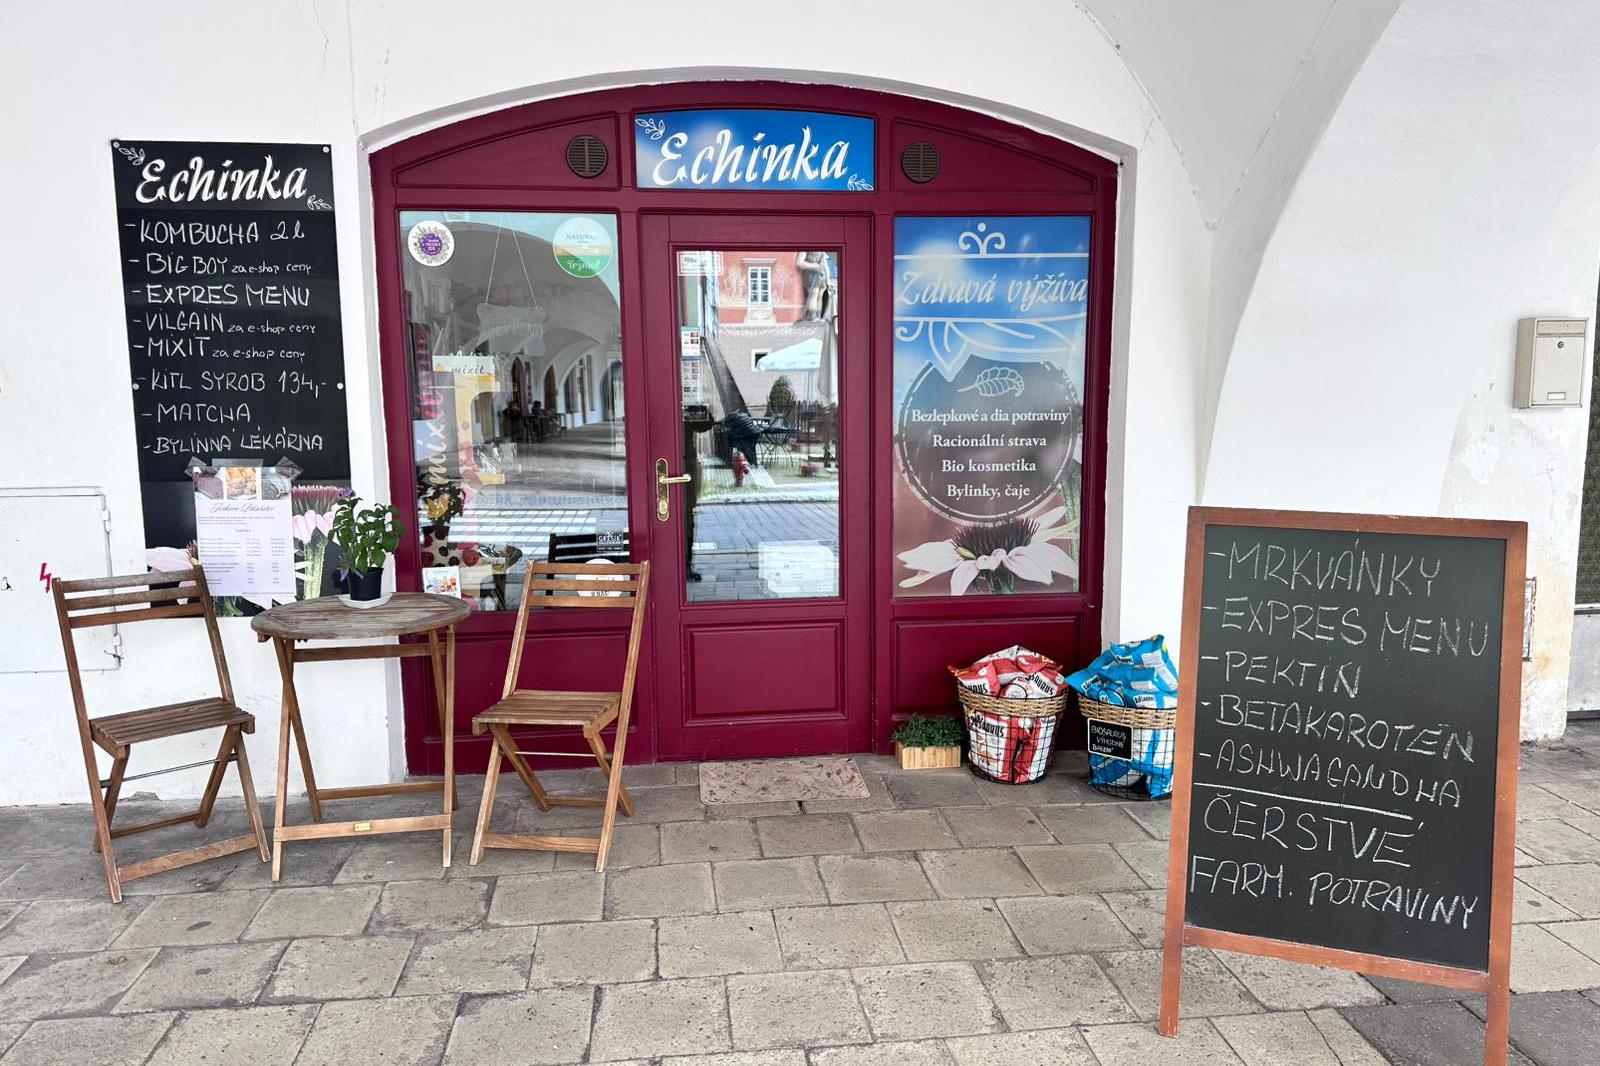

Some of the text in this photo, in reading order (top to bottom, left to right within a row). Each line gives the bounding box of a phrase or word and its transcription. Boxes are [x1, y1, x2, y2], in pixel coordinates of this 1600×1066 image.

[652, 125, 850, 186] Echinka
[135, 154, 308, 203] Echinka
[270, 220, 288, 240] 2
[192, 255, 228, 275] BOY
[231, 264, 247, 274] za
[245, 282, 309, 306] MENU
[896, 270, 1089, 312] Zdravá výživa
[227, 324, 244, 334] za
[212, 349, 229, 358] za
[232, 346, 275, 360] e-shop
[201, 370, 265, 391] SYROB
[911, 408, 1070, 426] Bezlepkové a dia potraviny
[932, 433, 1047, 448] Racionální strava
[941, 459, 1037, 473] Bio kosmetika
[946, 483, 1031, 501] Bylinky, čaje
[1380, 611, 1489, 657] MENU
[1203, 792, 1424, 868] ČERSTVÉ
[1190, 854, 1479, 929] FARM. POTRAVINY
